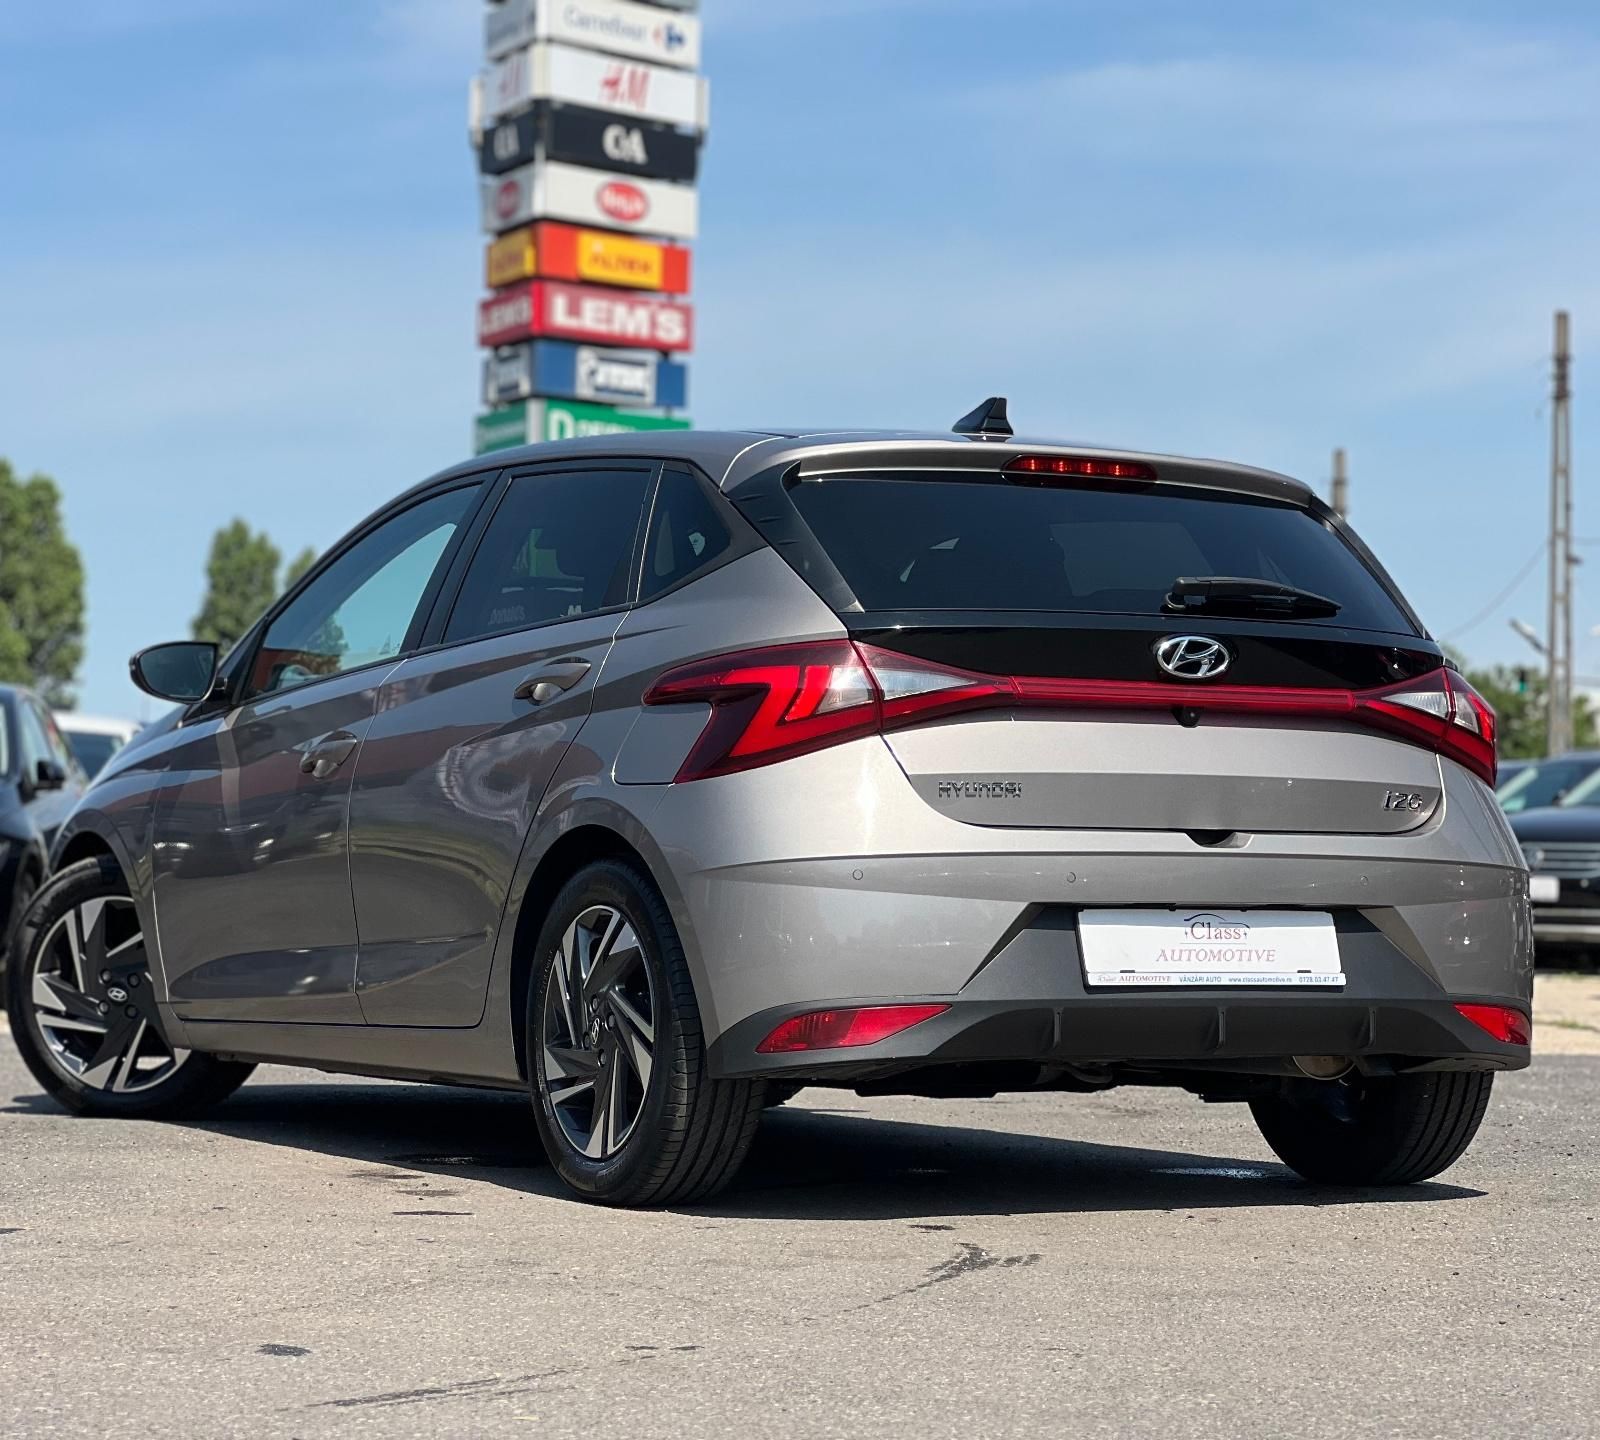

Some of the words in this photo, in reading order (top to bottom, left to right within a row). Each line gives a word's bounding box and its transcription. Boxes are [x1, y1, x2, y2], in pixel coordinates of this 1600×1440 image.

[938, 781, 1022, 799] HYUNDAI
[1189, 921, 1242, 940] Class
[1156, 949, 1276, 962] AUTOMOTIVE
[1119, 975, 1171, 983] AUTOMOTIVE
